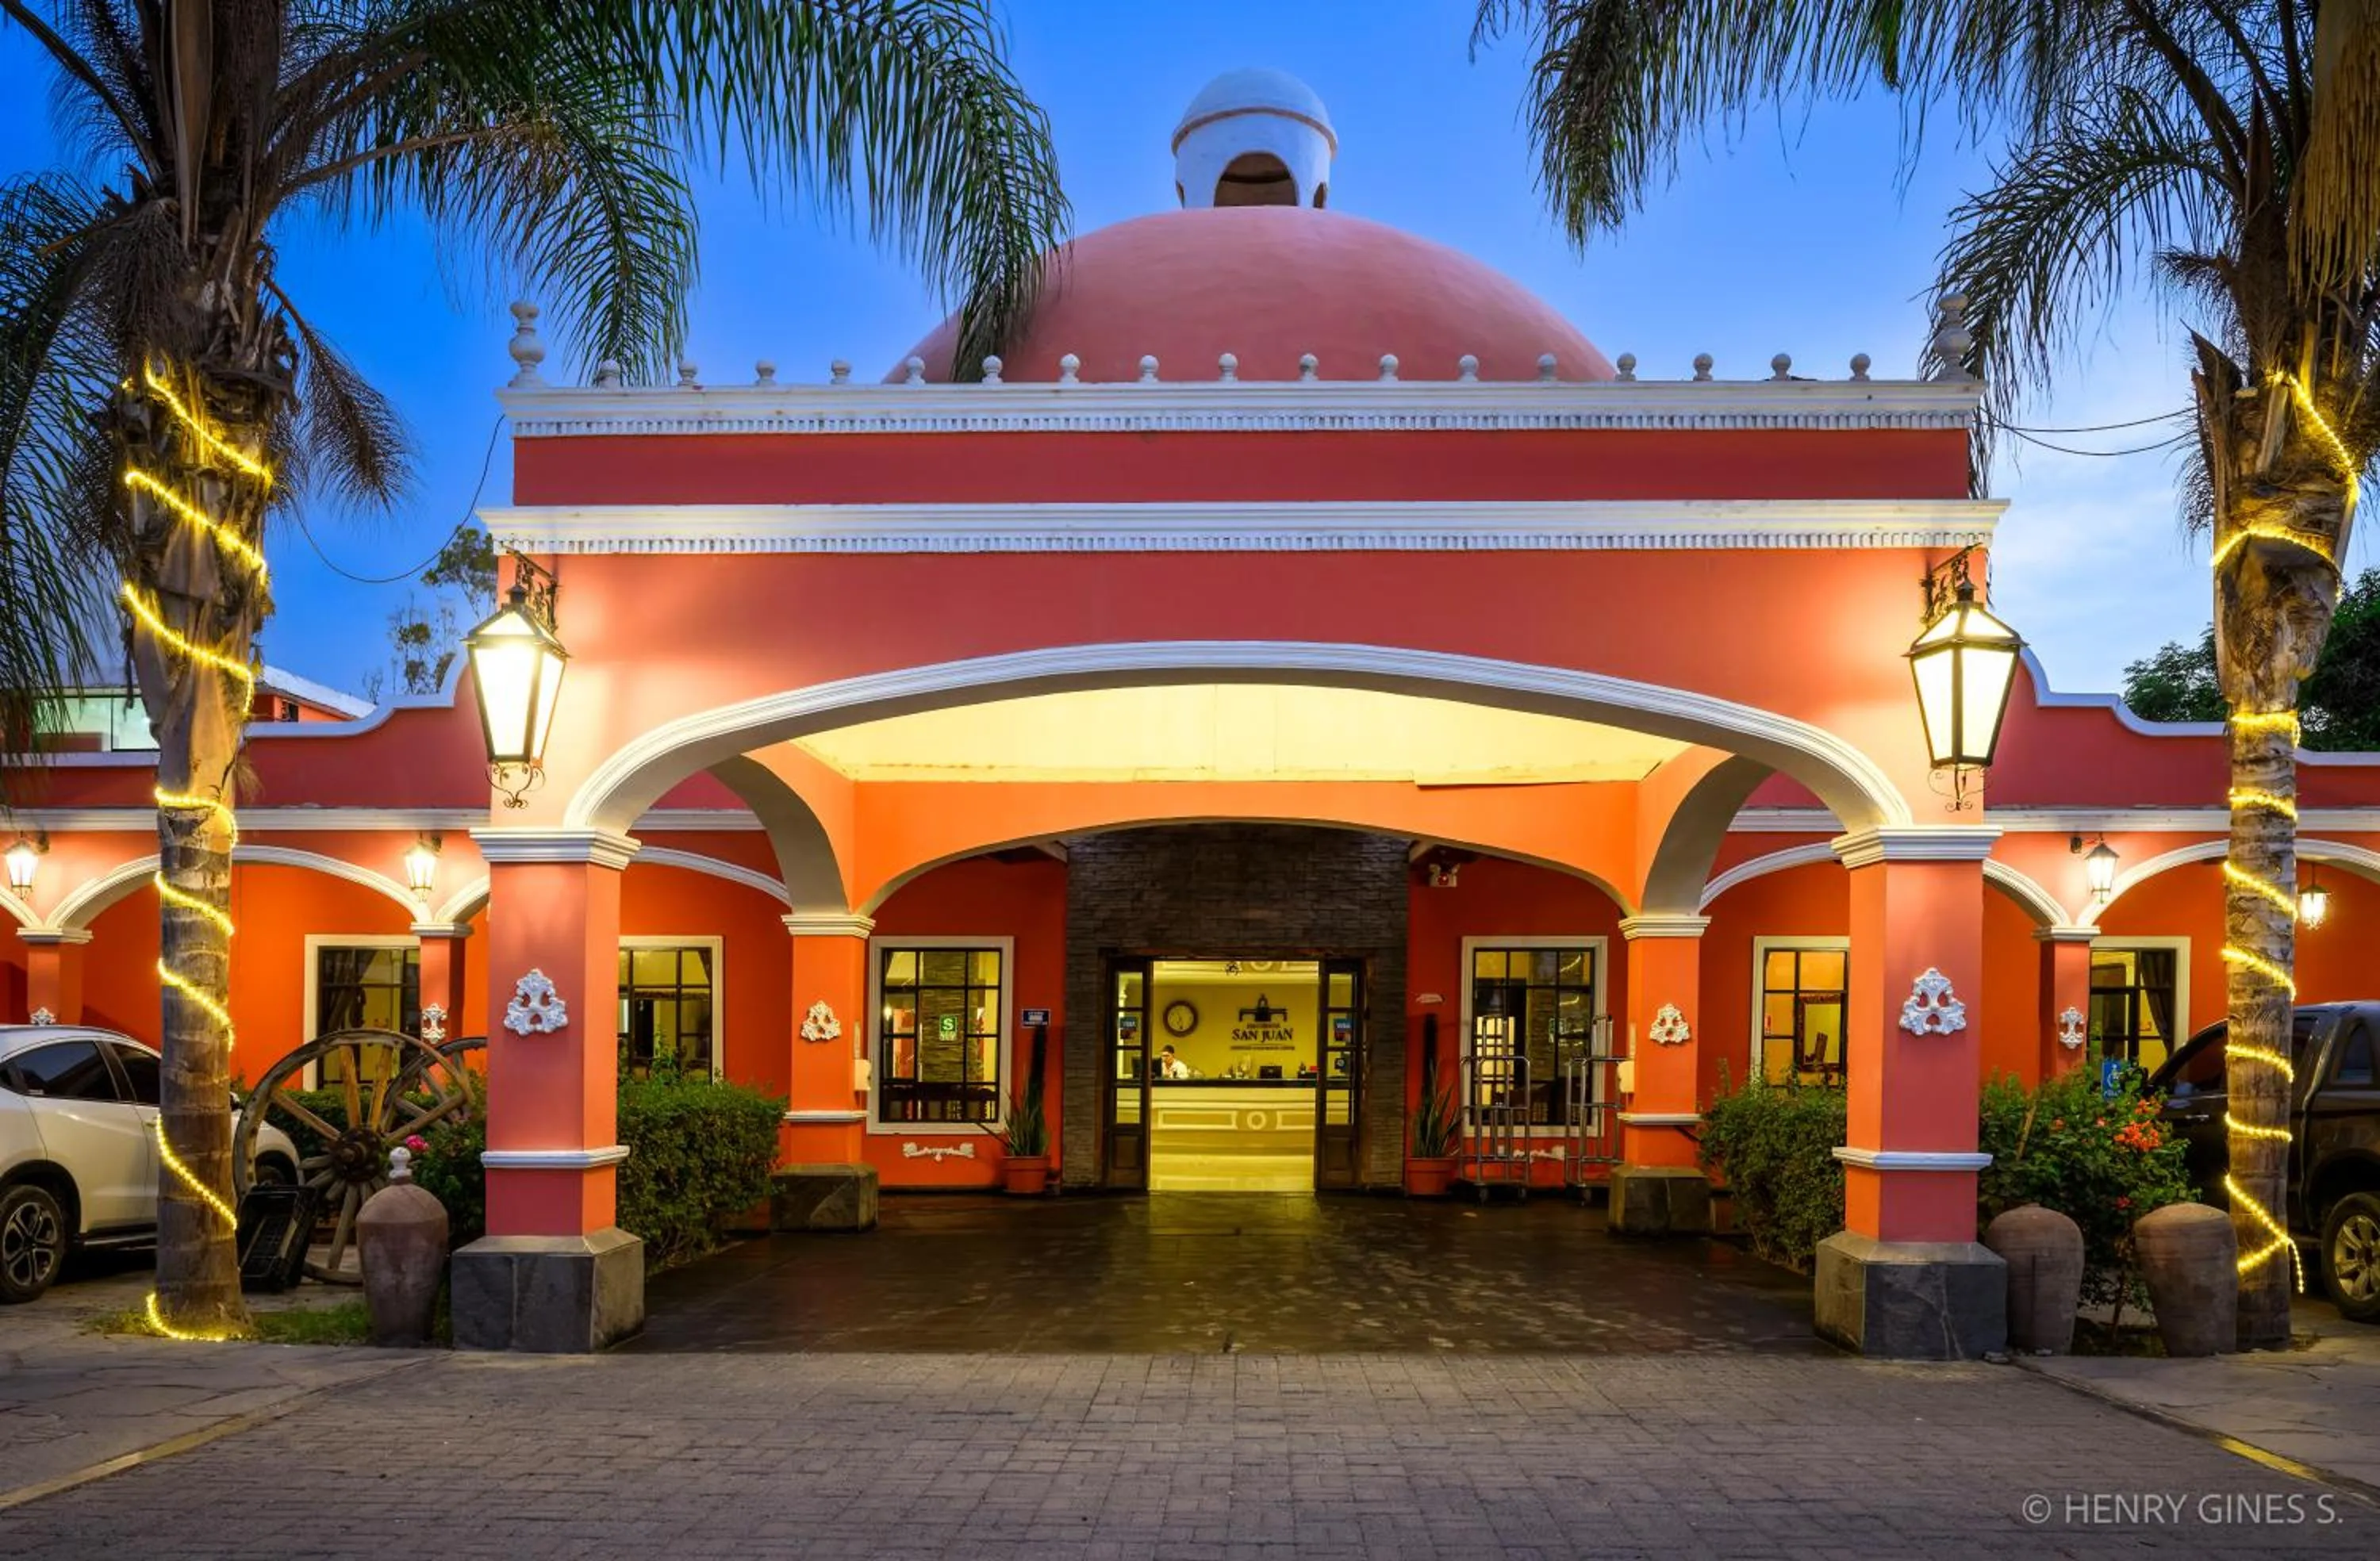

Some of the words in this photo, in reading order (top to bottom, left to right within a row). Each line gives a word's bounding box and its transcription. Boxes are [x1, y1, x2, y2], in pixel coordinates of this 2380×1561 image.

[942, 1018, 954, 1030] S
[1231, 1028, 1258, 1041] SAN
[1261, 1028, 1294, 1043] JUAN
